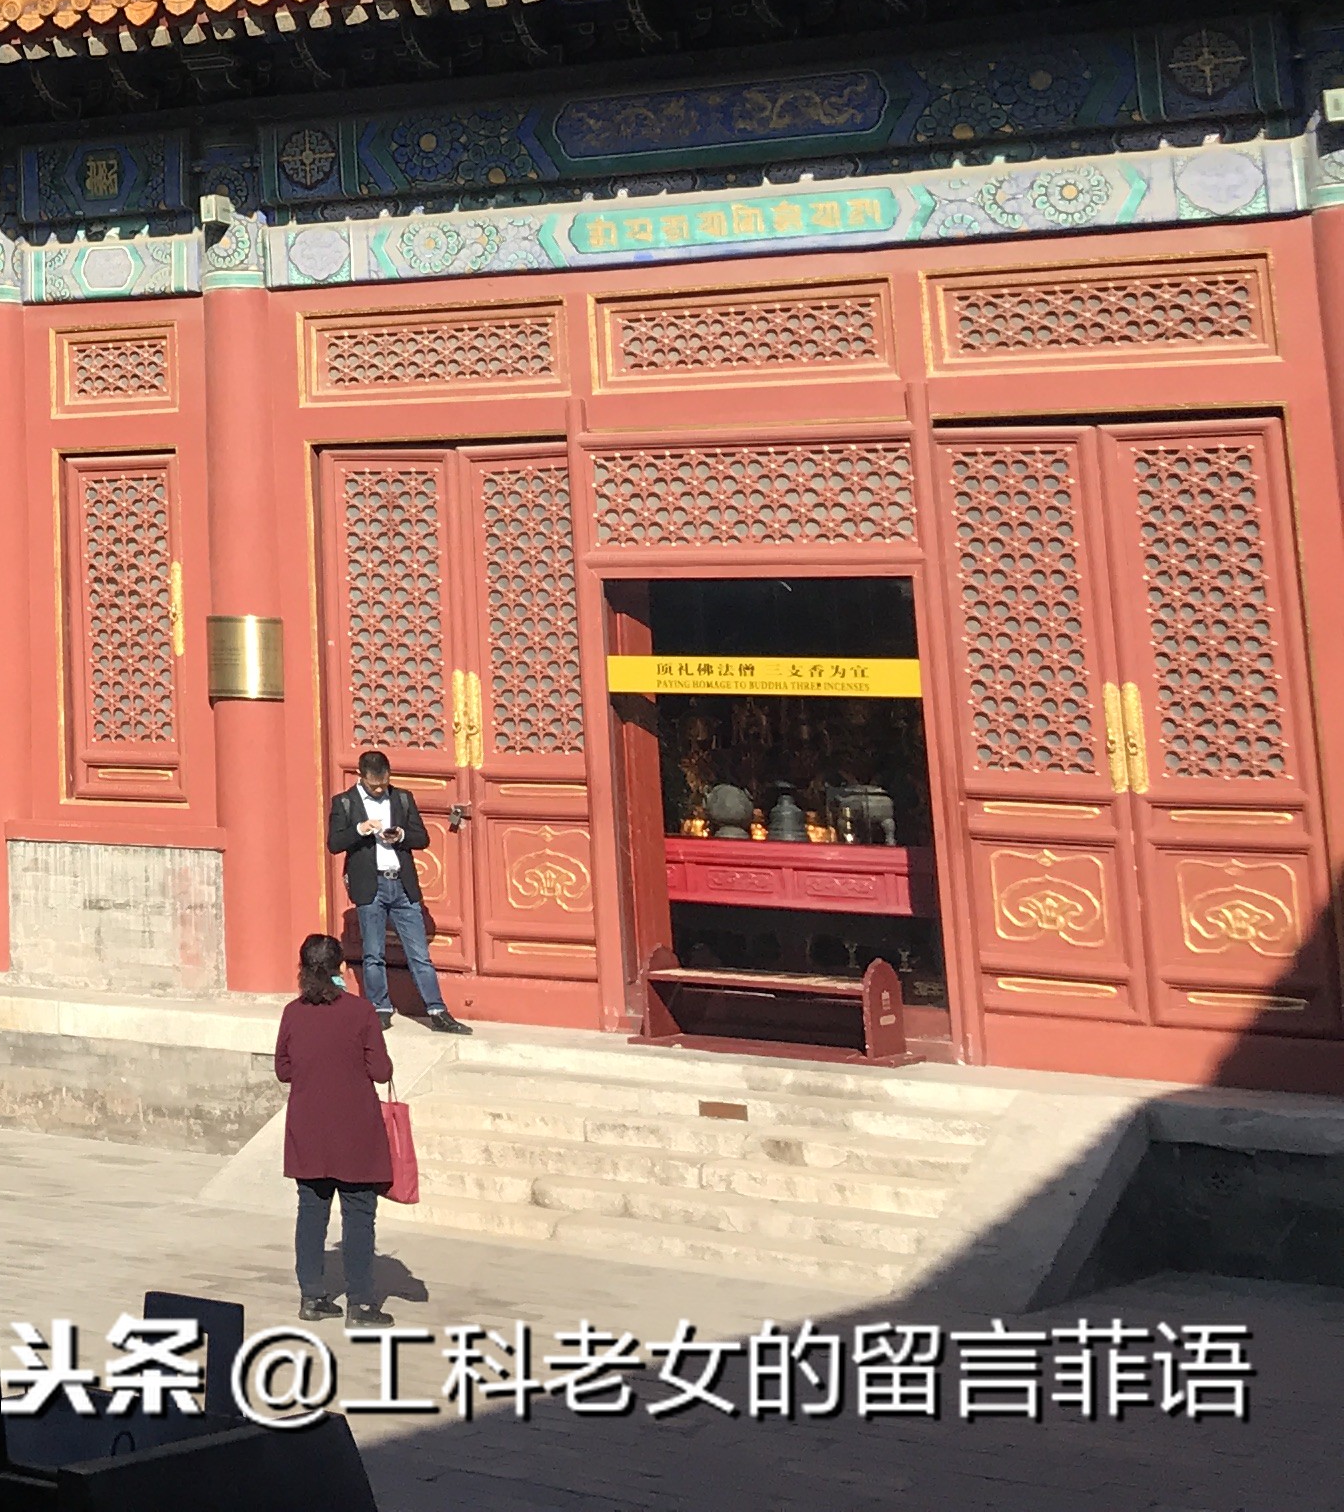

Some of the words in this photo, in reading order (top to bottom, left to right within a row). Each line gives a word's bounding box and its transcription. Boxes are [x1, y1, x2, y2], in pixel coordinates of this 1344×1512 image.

[656, 662, 755, 677] 顶礼佛法僧
[766, 663, 869, 679] 三支香为宜
[656, 679, 690, 689] PAYING
[692, 680, 732, 690] HOMAGE
[734, 680, 747, 690] TO
[749, 680, 788, 691] BUDDHA
[791, 681, 821, 691] THREE
[823, 681, 870, 692] INCENSES
